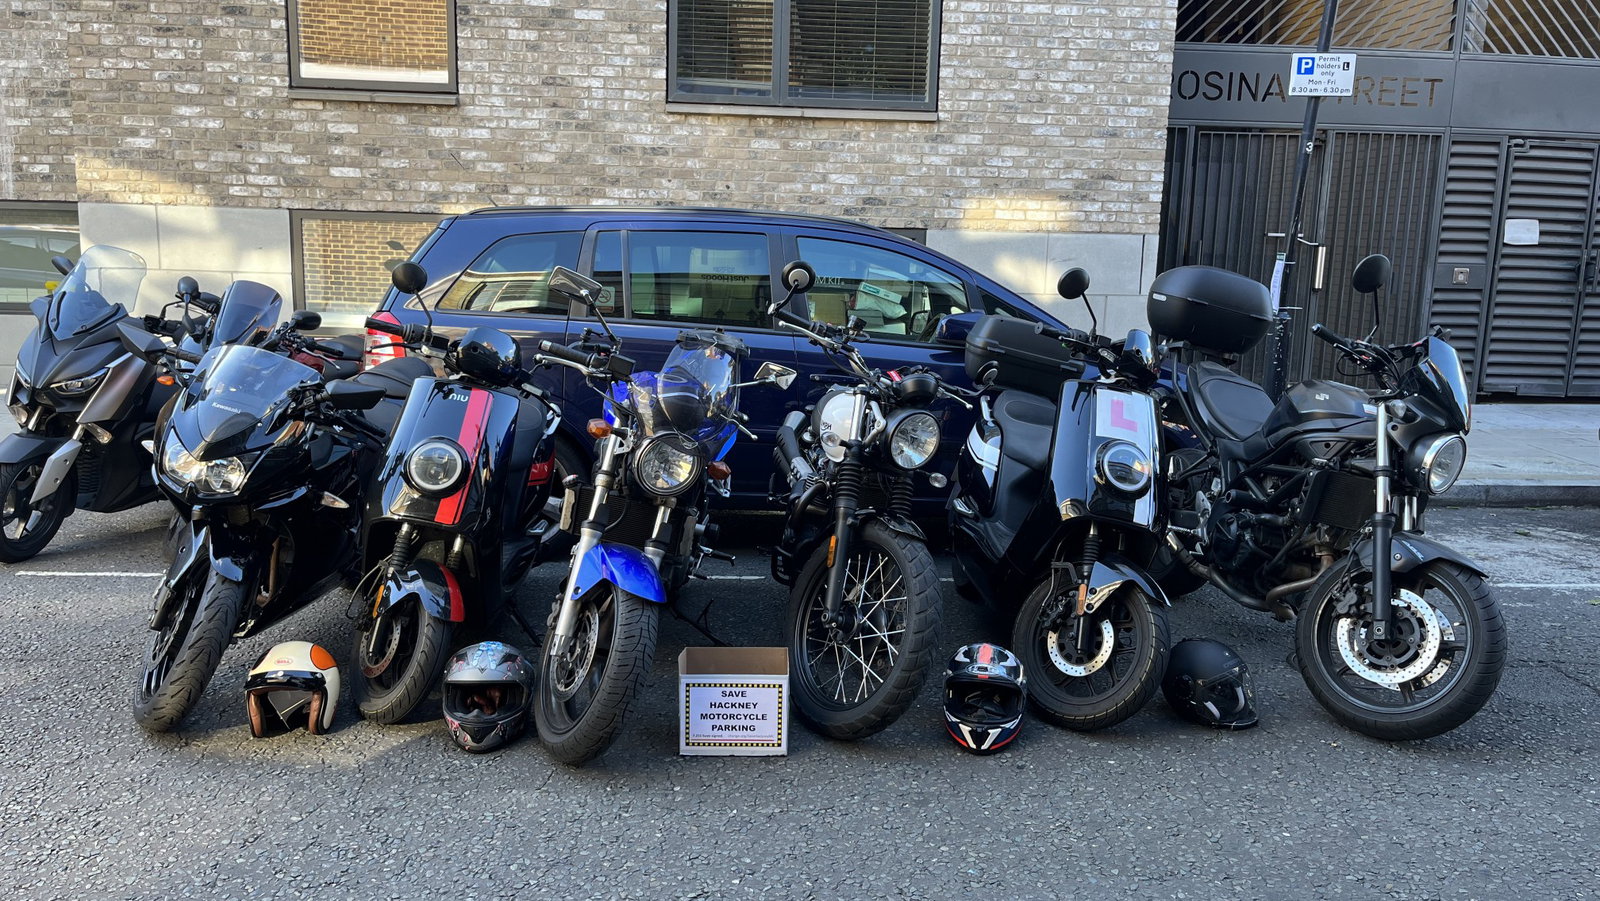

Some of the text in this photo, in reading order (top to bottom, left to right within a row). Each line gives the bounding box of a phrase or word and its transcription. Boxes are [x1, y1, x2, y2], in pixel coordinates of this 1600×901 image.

[1300, 58, 1313, 74] P
[1171, 70, 1443, 107] OSINA REET
[1111, 399, 1138, 432] L
[721, 690, 747, 698] SAVE
[700, 713, 768, 721] MOTORCYCLE
[711, 724, 756, 732] PARKING
